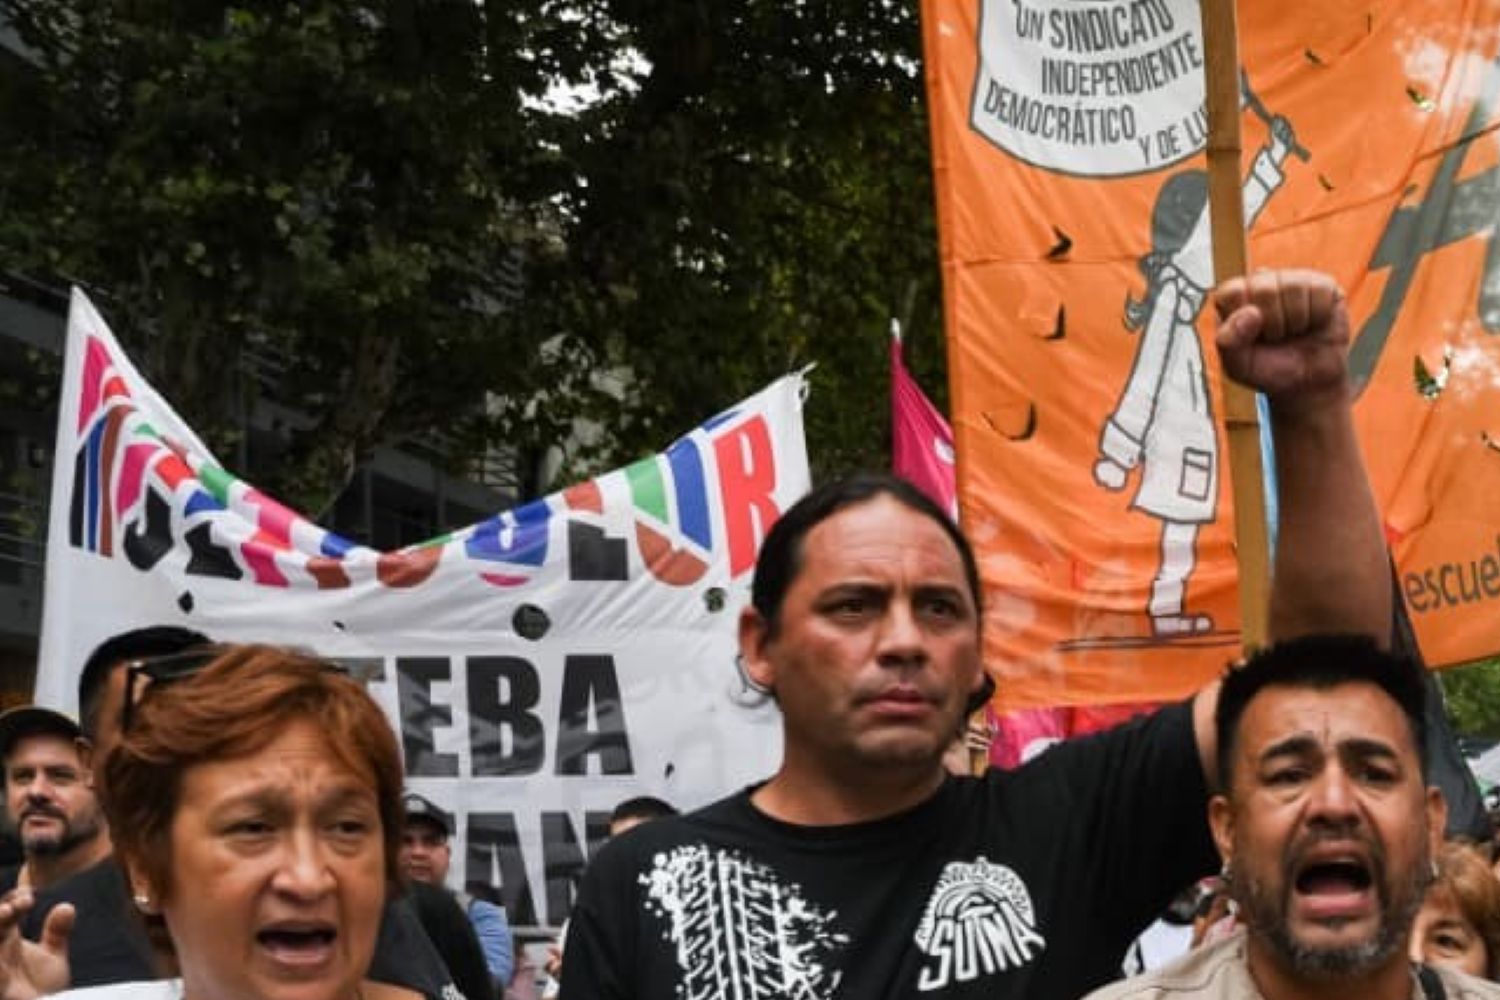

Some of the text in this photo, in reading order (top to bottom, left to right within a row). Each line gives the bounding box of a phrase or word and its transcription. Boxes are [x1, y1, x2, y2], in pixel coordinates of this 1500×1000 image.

[1049, 0, 1175, 53] SINDICATO
[1041, 31, 1202, 96] INDEPENDIENTE
[983, 78, 1137, 147] DEMOCRÁTICO
[1138, 105, 1213, 166] Y DE LU
[335, 654, 635, 778] EBA
